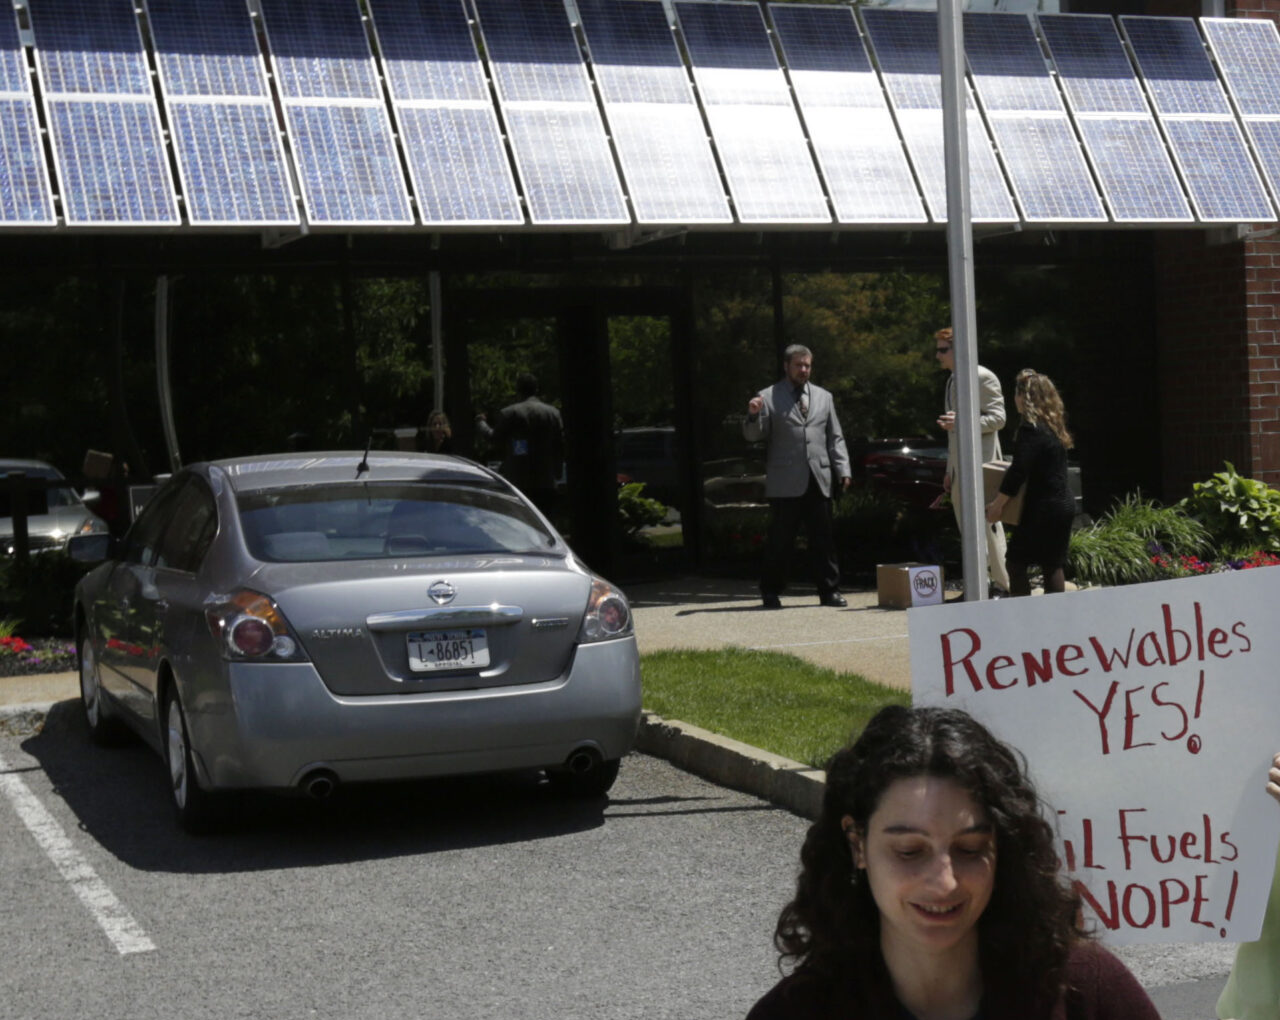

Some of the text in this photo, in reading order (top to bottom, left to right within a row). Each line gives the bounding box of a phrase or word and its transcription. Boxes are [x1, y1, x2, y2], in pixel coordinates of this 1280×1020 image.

[940, 601, 1251, 697] Renewables
[1072, 670, 1204, 755] YES!
[1071, 869, 1240, 938] NOPE!
